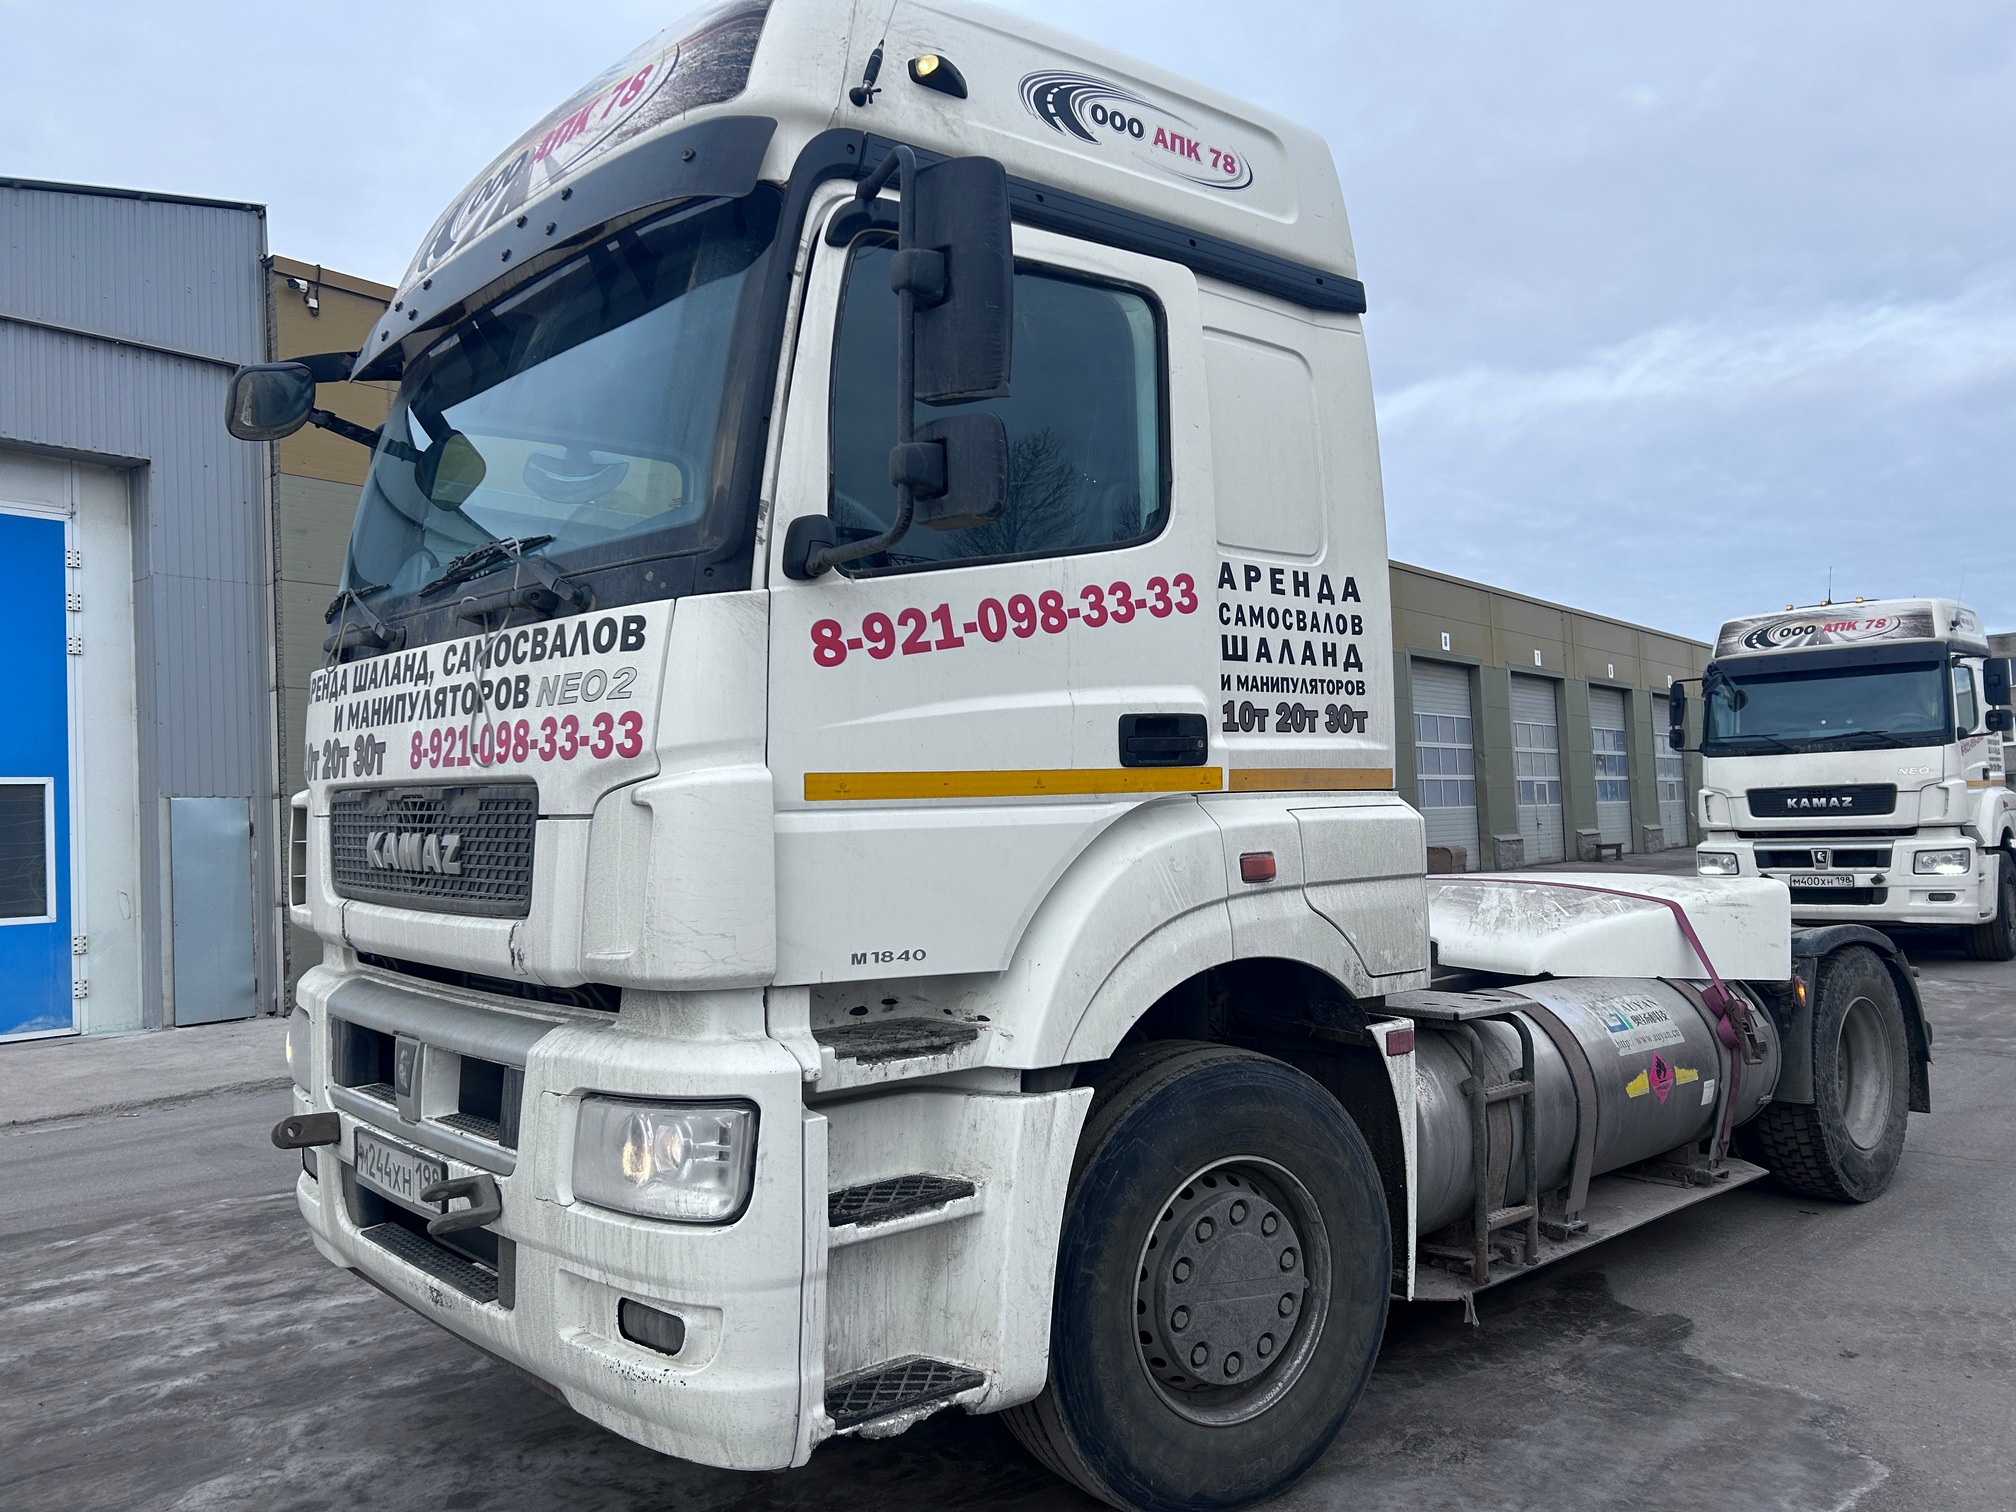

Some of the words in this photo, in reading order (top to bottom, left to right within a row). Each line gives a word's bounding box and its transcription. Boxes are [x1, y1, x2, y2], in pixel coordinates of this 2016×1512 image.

[523, 97, 601, 173] АПК
[600, 64, 654, 120] 78
[1090, 103, 1145, 139] ООО
[1153, 127, 1201, 163] АПК
[1209, 148, 1237, 175] 78
[1217, 561, 1361, 606] АРЕНДА
[810, 572, 1199, 668] 8-921-098-33-33
[1218, 602, 1364, 636] САМОСВАЛОВ
[1779, 625, 1817, 638] ООО
[1821, 620, 1859, 633] АПК
[1865, 618, 1887, 630] 78
[308, 668, 348, 705] РЕНДА
[352, 650, 434, 695] ШАЛАНД,
[442, 614, 647, 677] САМОСВАЛОВ
[1221, 634, 1363, 672] ШАЛАНД
[333, 704, 344, 733] И
[347, 674, 530, 731] МАНИПУЛЯТОРОВ
[1220, 673, 1231, 691] И
[1237, 674, 1366, 696] МАНИПУЛЯТОРОВ
[410, 710, 644, 770] 8-921-098-33-33
[1897, 766, 1930, 776] NEO
[1786, 796, 1853, 809] KAMAZ
[366, 830, 463, 875] KAMAZ
